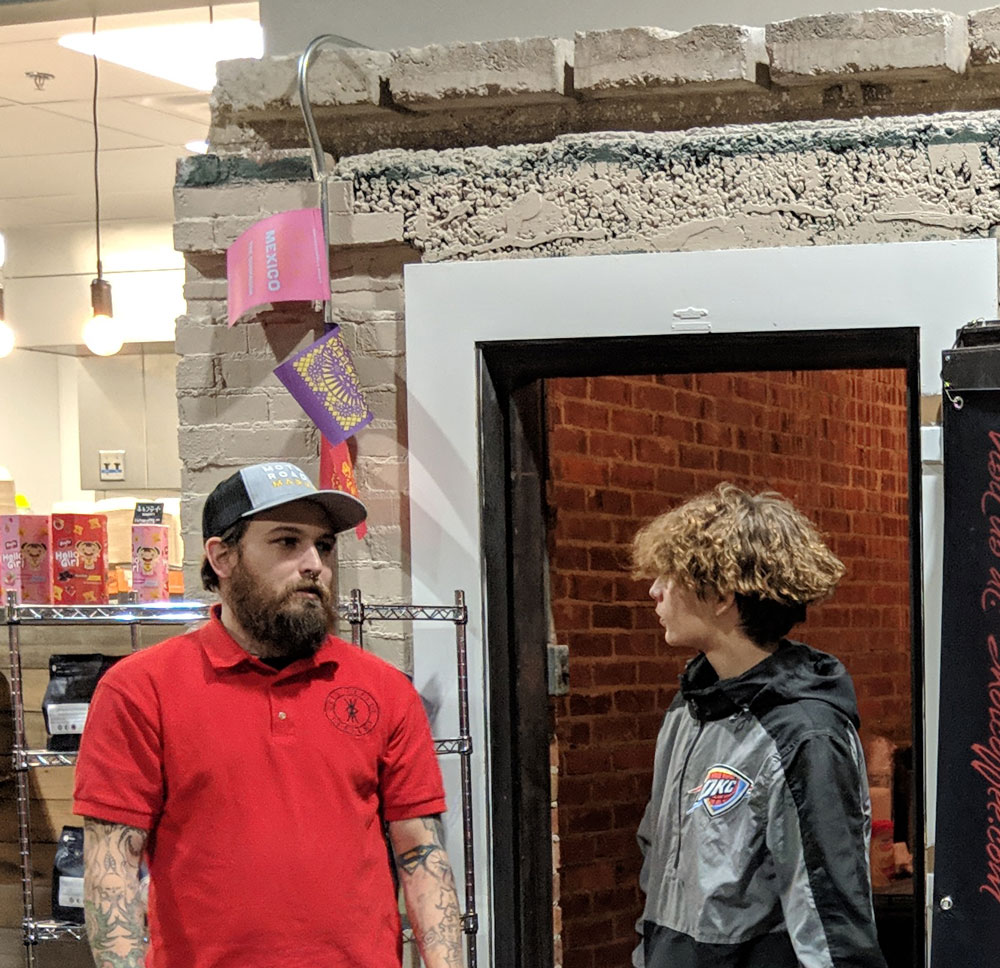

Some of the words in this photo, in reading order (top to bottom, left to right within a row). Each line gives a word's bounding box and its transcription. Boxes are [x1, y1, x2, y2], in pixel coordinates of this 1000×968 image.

[265, 229, 281, 292] MEXICO
[55, 551, 80, 561] Hello
[699, 779, 737, 800] OKC
